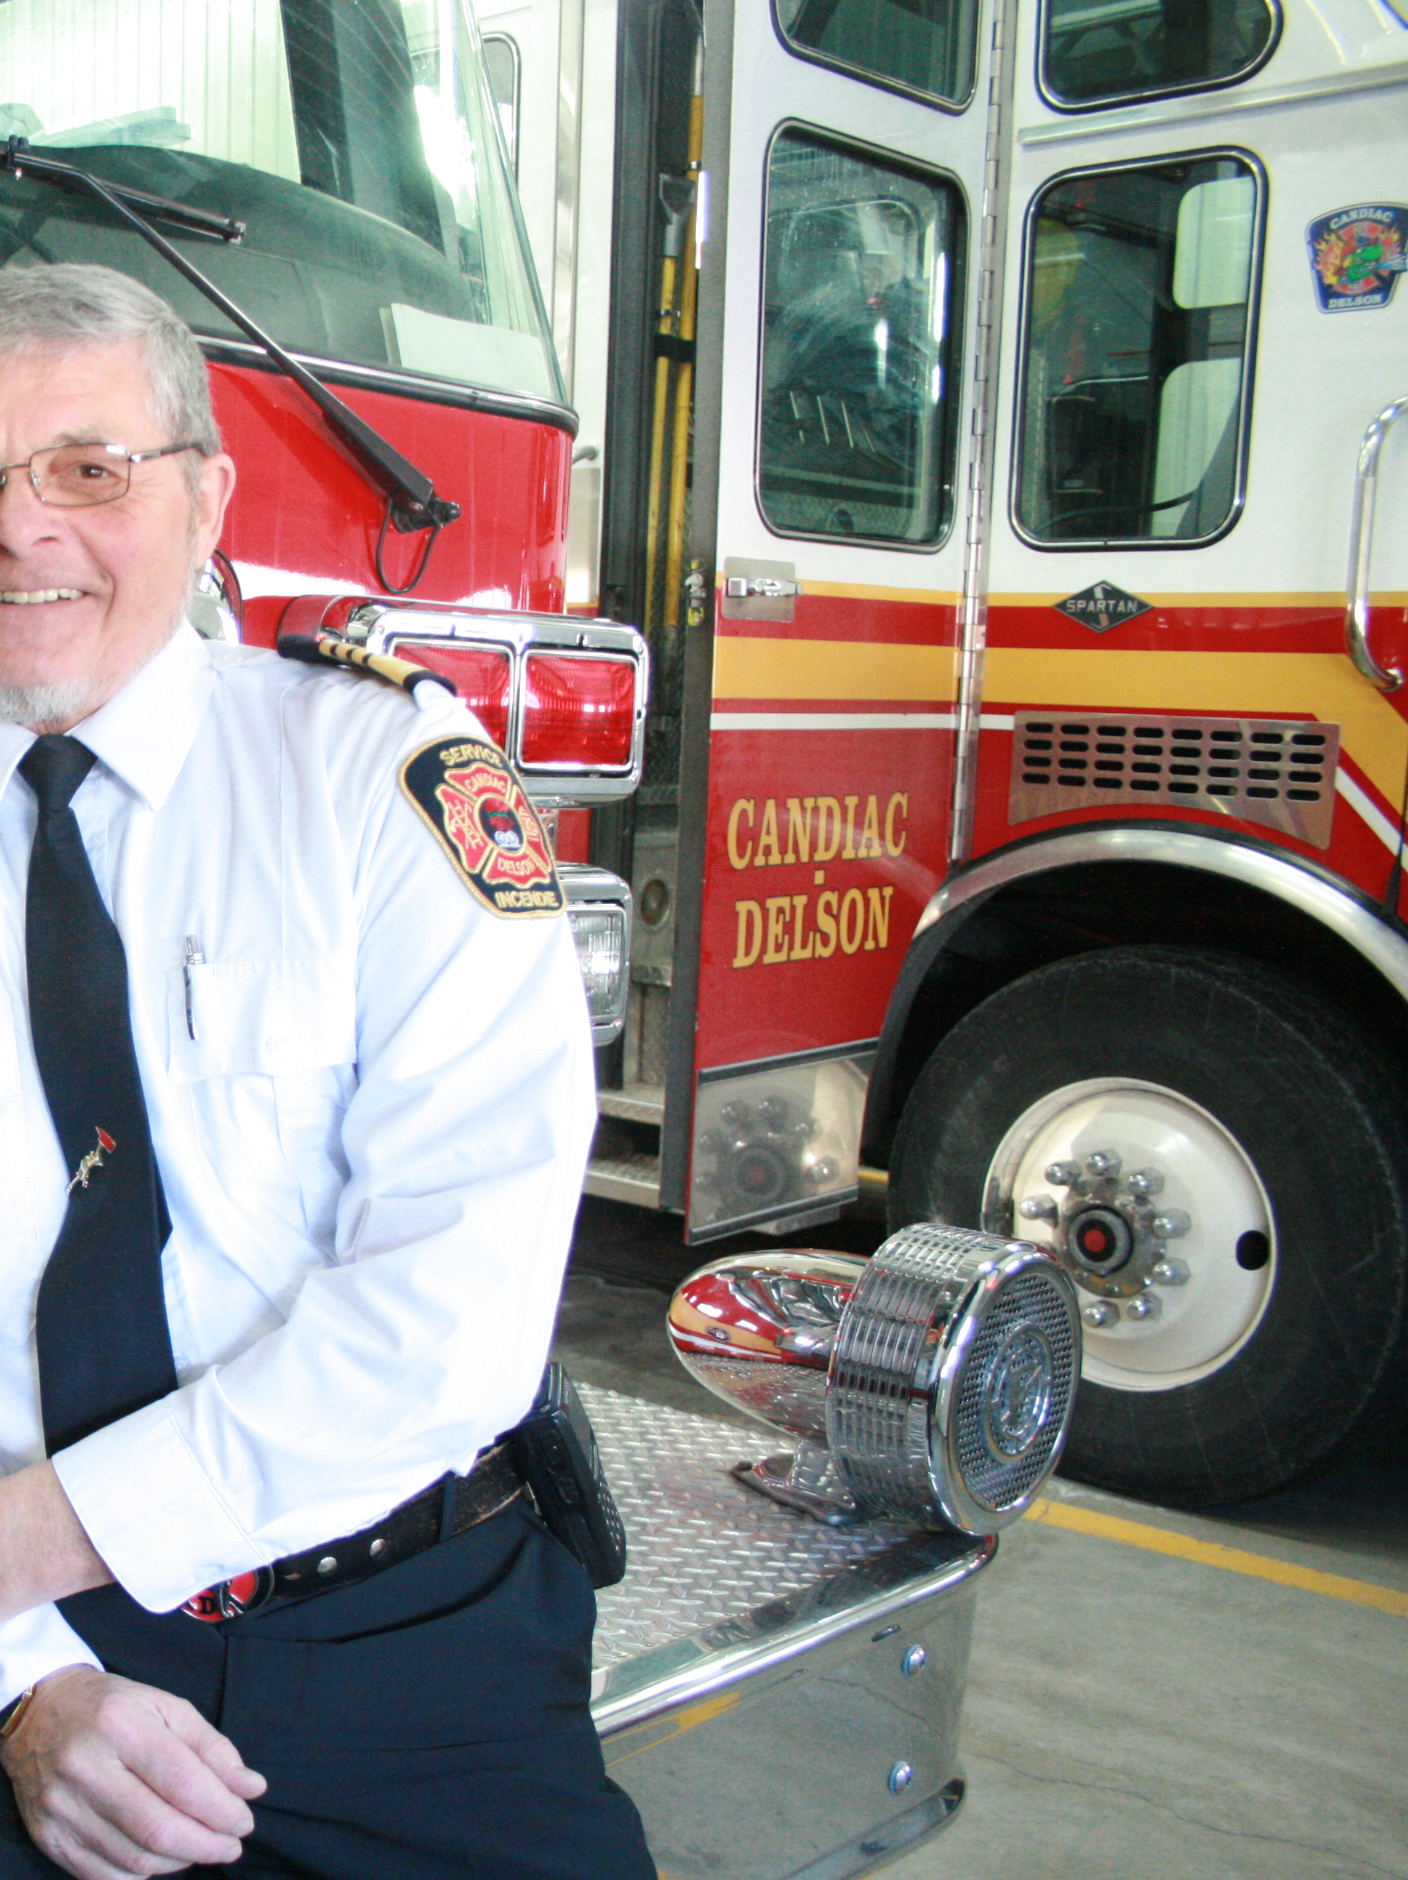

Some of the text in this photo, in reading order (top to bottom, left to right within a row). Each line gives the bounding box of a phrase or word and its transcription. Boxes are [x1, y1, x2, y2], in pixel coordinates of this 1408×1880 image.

[1330, 208, 1394, 229] CANDIAC
[1328, 294, 1382, 308] DELSON
[1065, 600, 1139, 613] SPARTAN
[440, 744, 501, 766] SERVICE
[465, 772, 506, 792] CANDIAC
[727, 792, 909, 870] CANDIAC
[497, 858, 535, 876] DELSON
[495, 891, 560, 908] INCENDIE
[733, 887, 894, 969] DELSON
